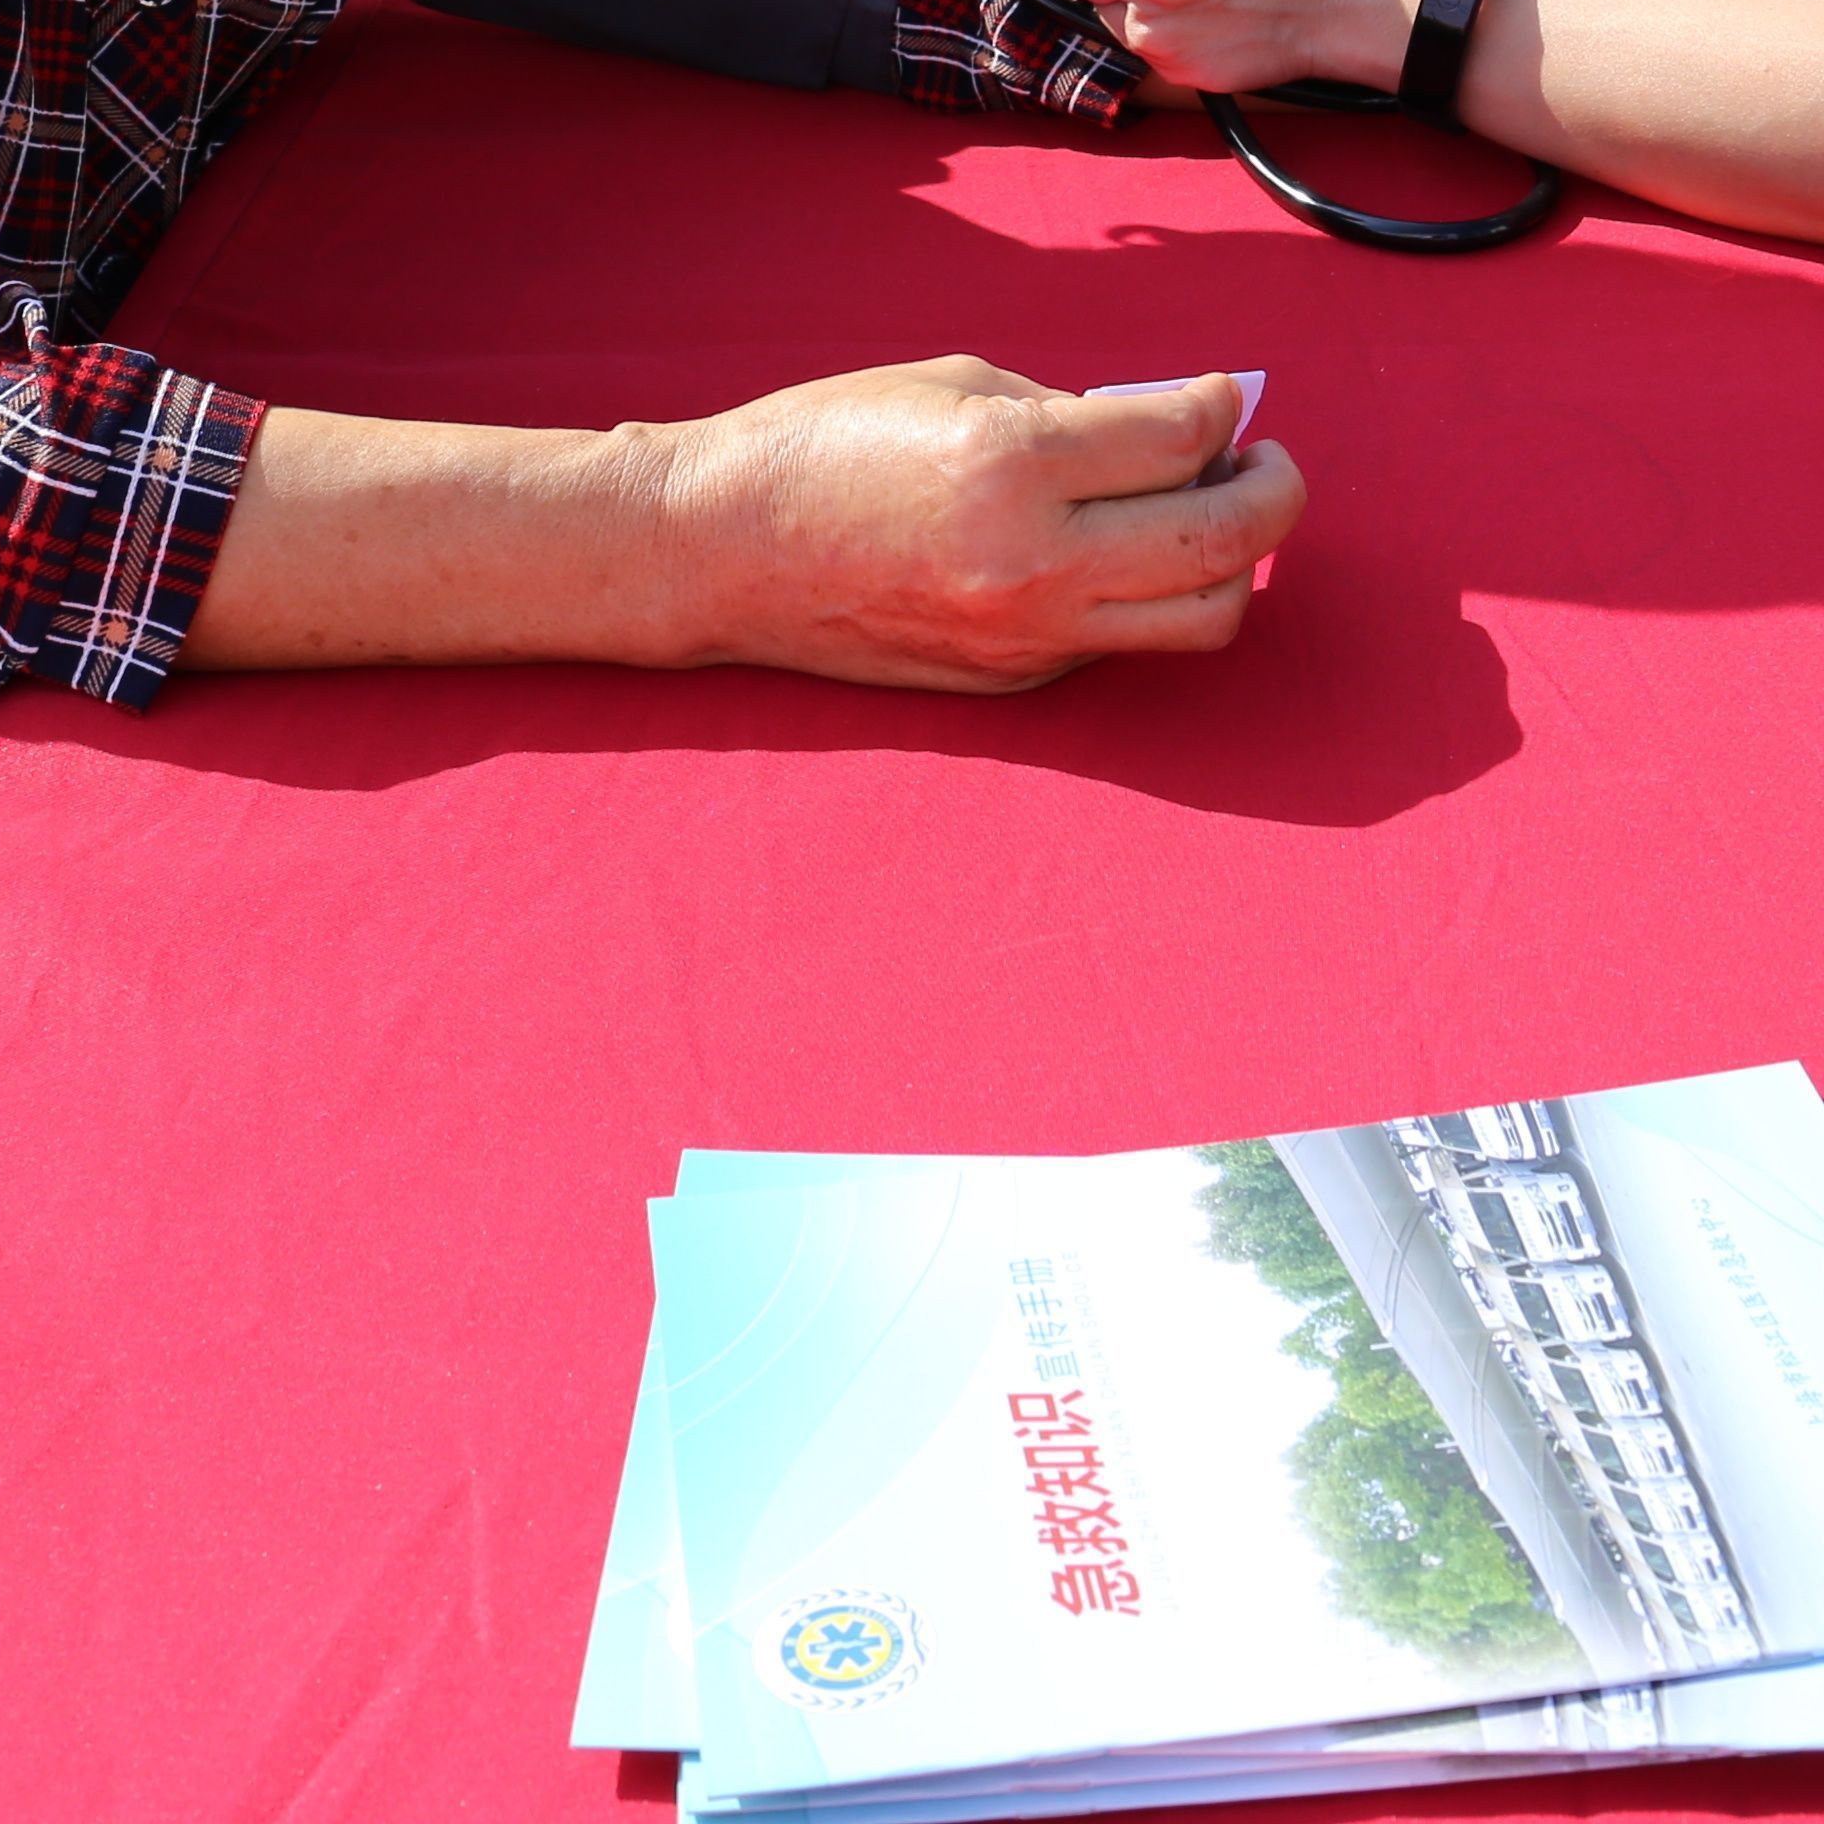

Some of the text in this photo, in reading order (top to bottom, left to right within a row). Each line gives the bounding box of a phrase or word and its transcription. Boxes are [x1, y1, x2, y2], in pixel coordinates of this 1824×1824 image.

[1007, 1256, 1142, 1618] 急救知识 宣传手册
